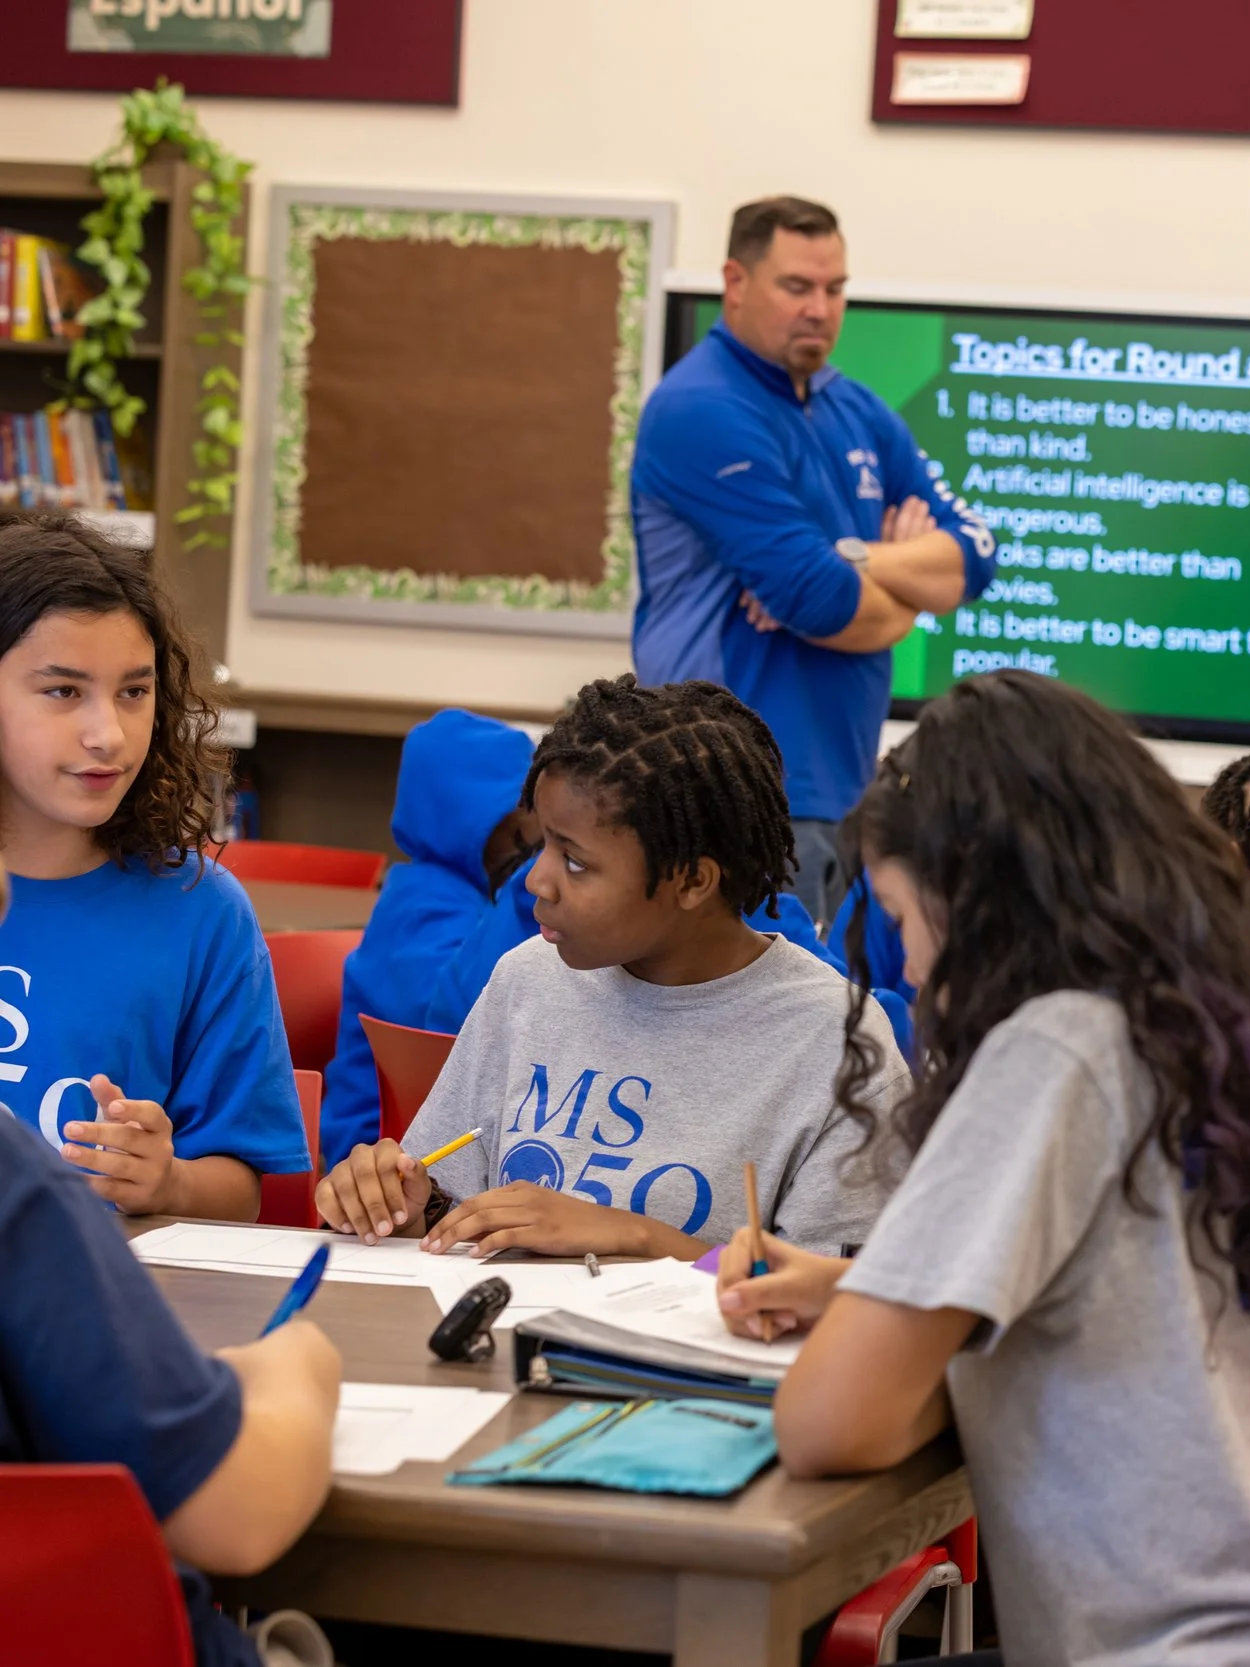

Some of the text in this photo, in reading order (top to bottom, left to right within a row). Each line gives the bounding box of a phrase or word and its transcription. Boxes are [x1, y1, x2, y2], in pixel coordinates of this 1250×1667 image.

[952, 333, 1064, 376] Topics
[1068, 338, 1122, 372] for
[1127, 343, 1241, 378] Round
[936, 389, 955, 418] 1.
[967, 391, 989, 420] It
[991, 392, 1014, 422] is
[1016, 394, 1099, 427] better
[1104, 400, 1134, 428] to
[1137, 400, 1173, 431] be
[966, 428, 1092, 462] than kind.
[963, 463, 1250, 509] Artificial intelligence is
[973, 499, 1107, 537] angerous.
[996, 539, 1242, 582] oks are better than
[982, 575, 1059, 606] ovies.
[955, 607, 976, 637] It
[979, 608, 1001, 640] is
[1003, 610, 1088, 645] better
[1092, 617, 1121, 647] to
[1124, 618, 1162, 650] be
[1164, 624, 1243, 656] smart
[506, 1063, 652, 1148] MS
